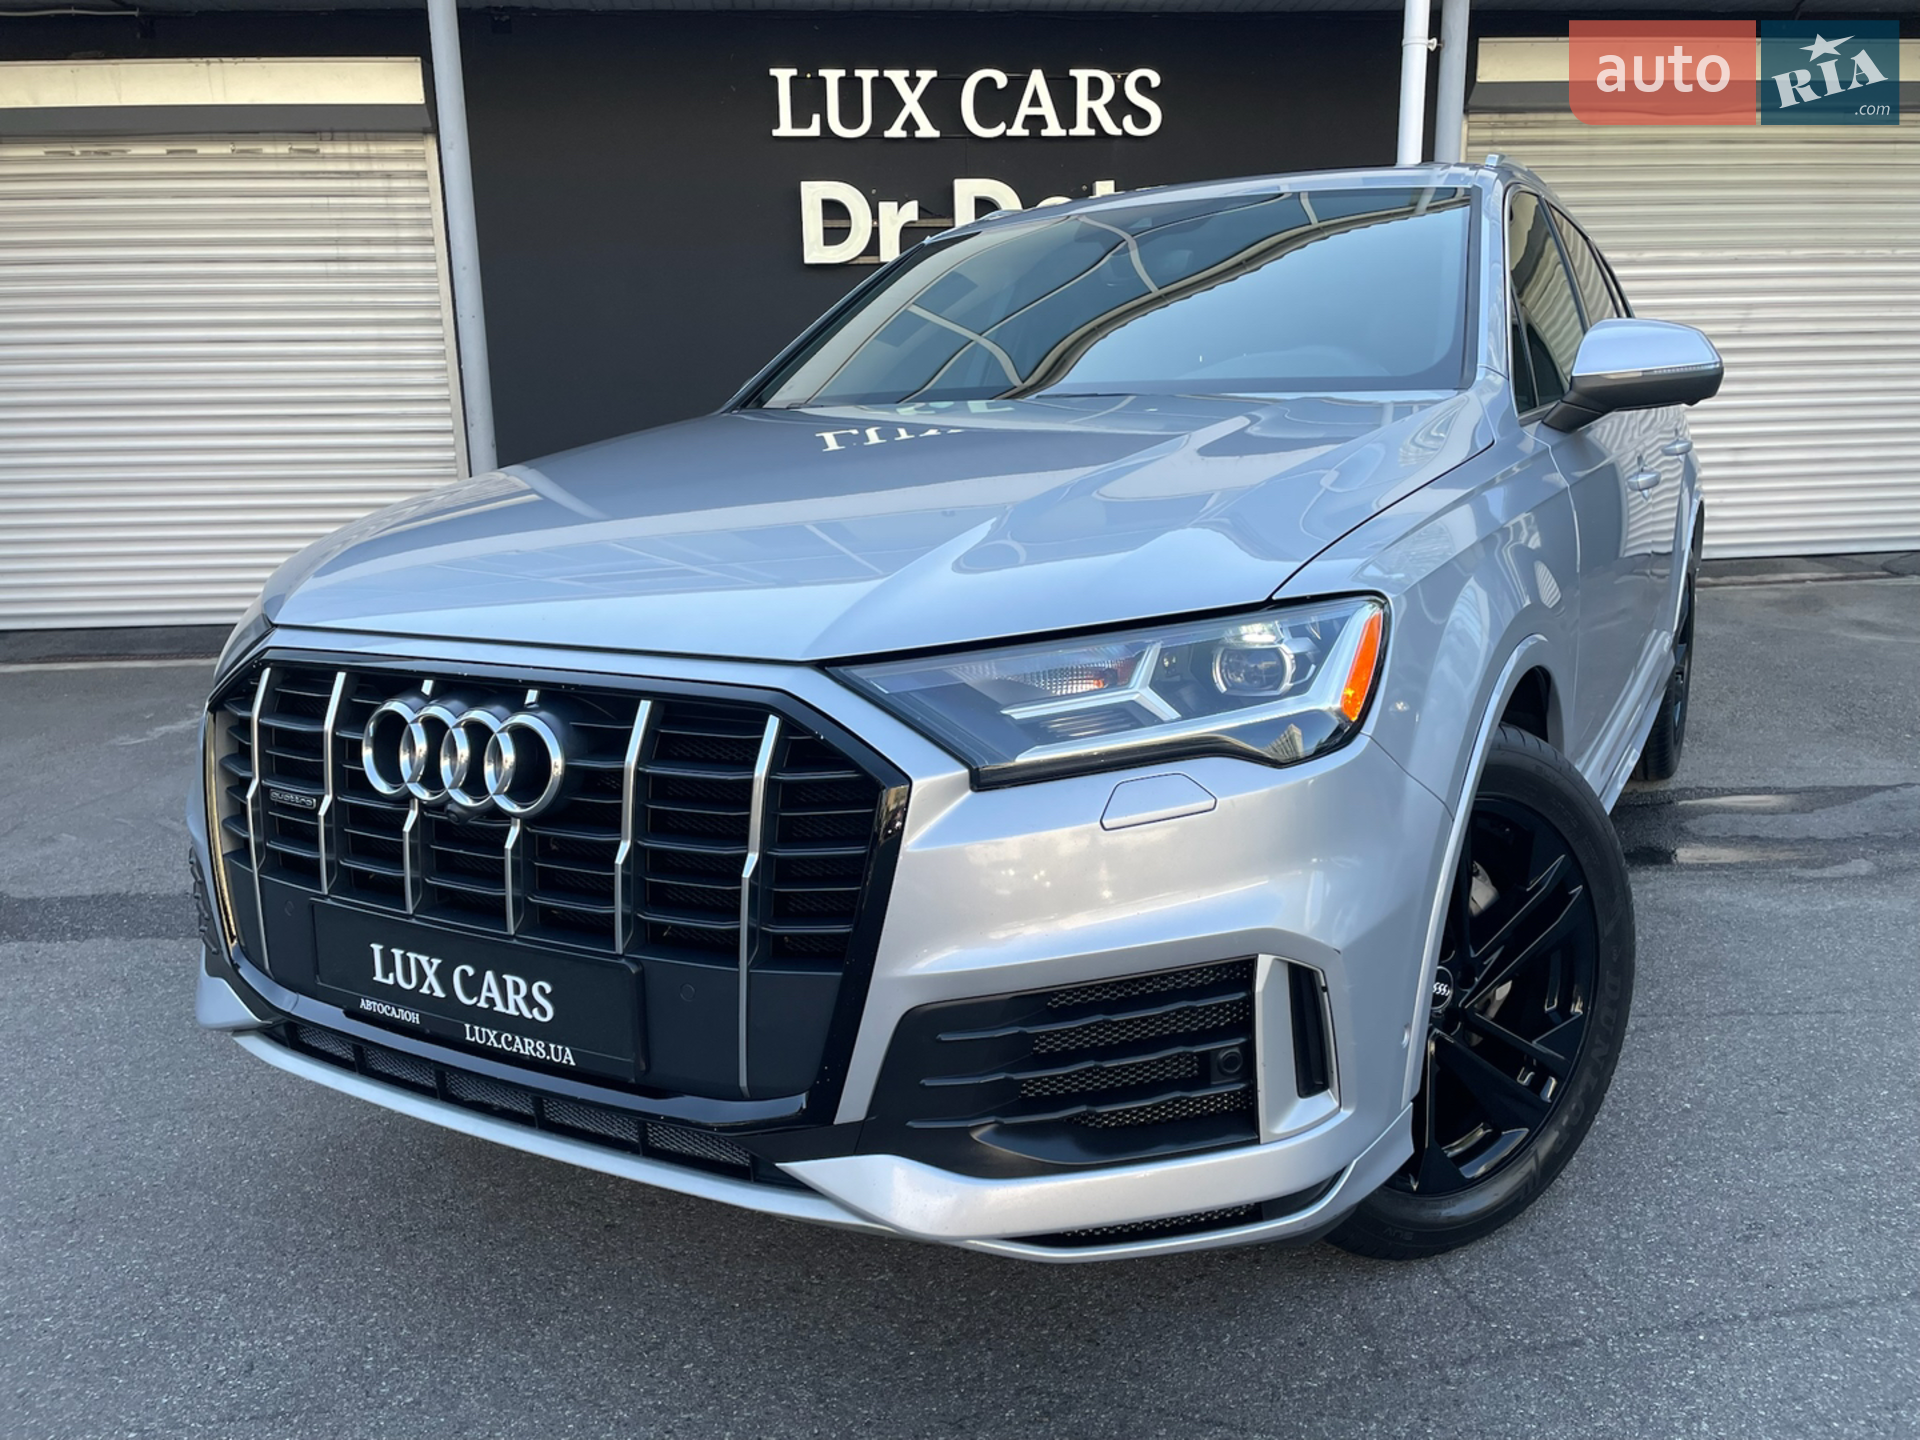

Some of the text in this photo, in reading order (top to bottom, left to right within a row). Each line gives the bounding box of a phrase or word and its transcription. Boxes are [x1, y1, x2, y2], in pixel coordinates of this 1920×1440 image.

[769, 68, 1163, 138] LUX CARS
[800, 180, 919, 264] Dr
[269, 790, 314, 807] quattro
[359, 998, 421, 1025] АВТОСАЛОН
[369, 942, 555, 1024] LUX CARS
[463, 1023, 577, 1067] LUX.CARS.UA
[1553, 969, 1622, 1155] DUNLOP
